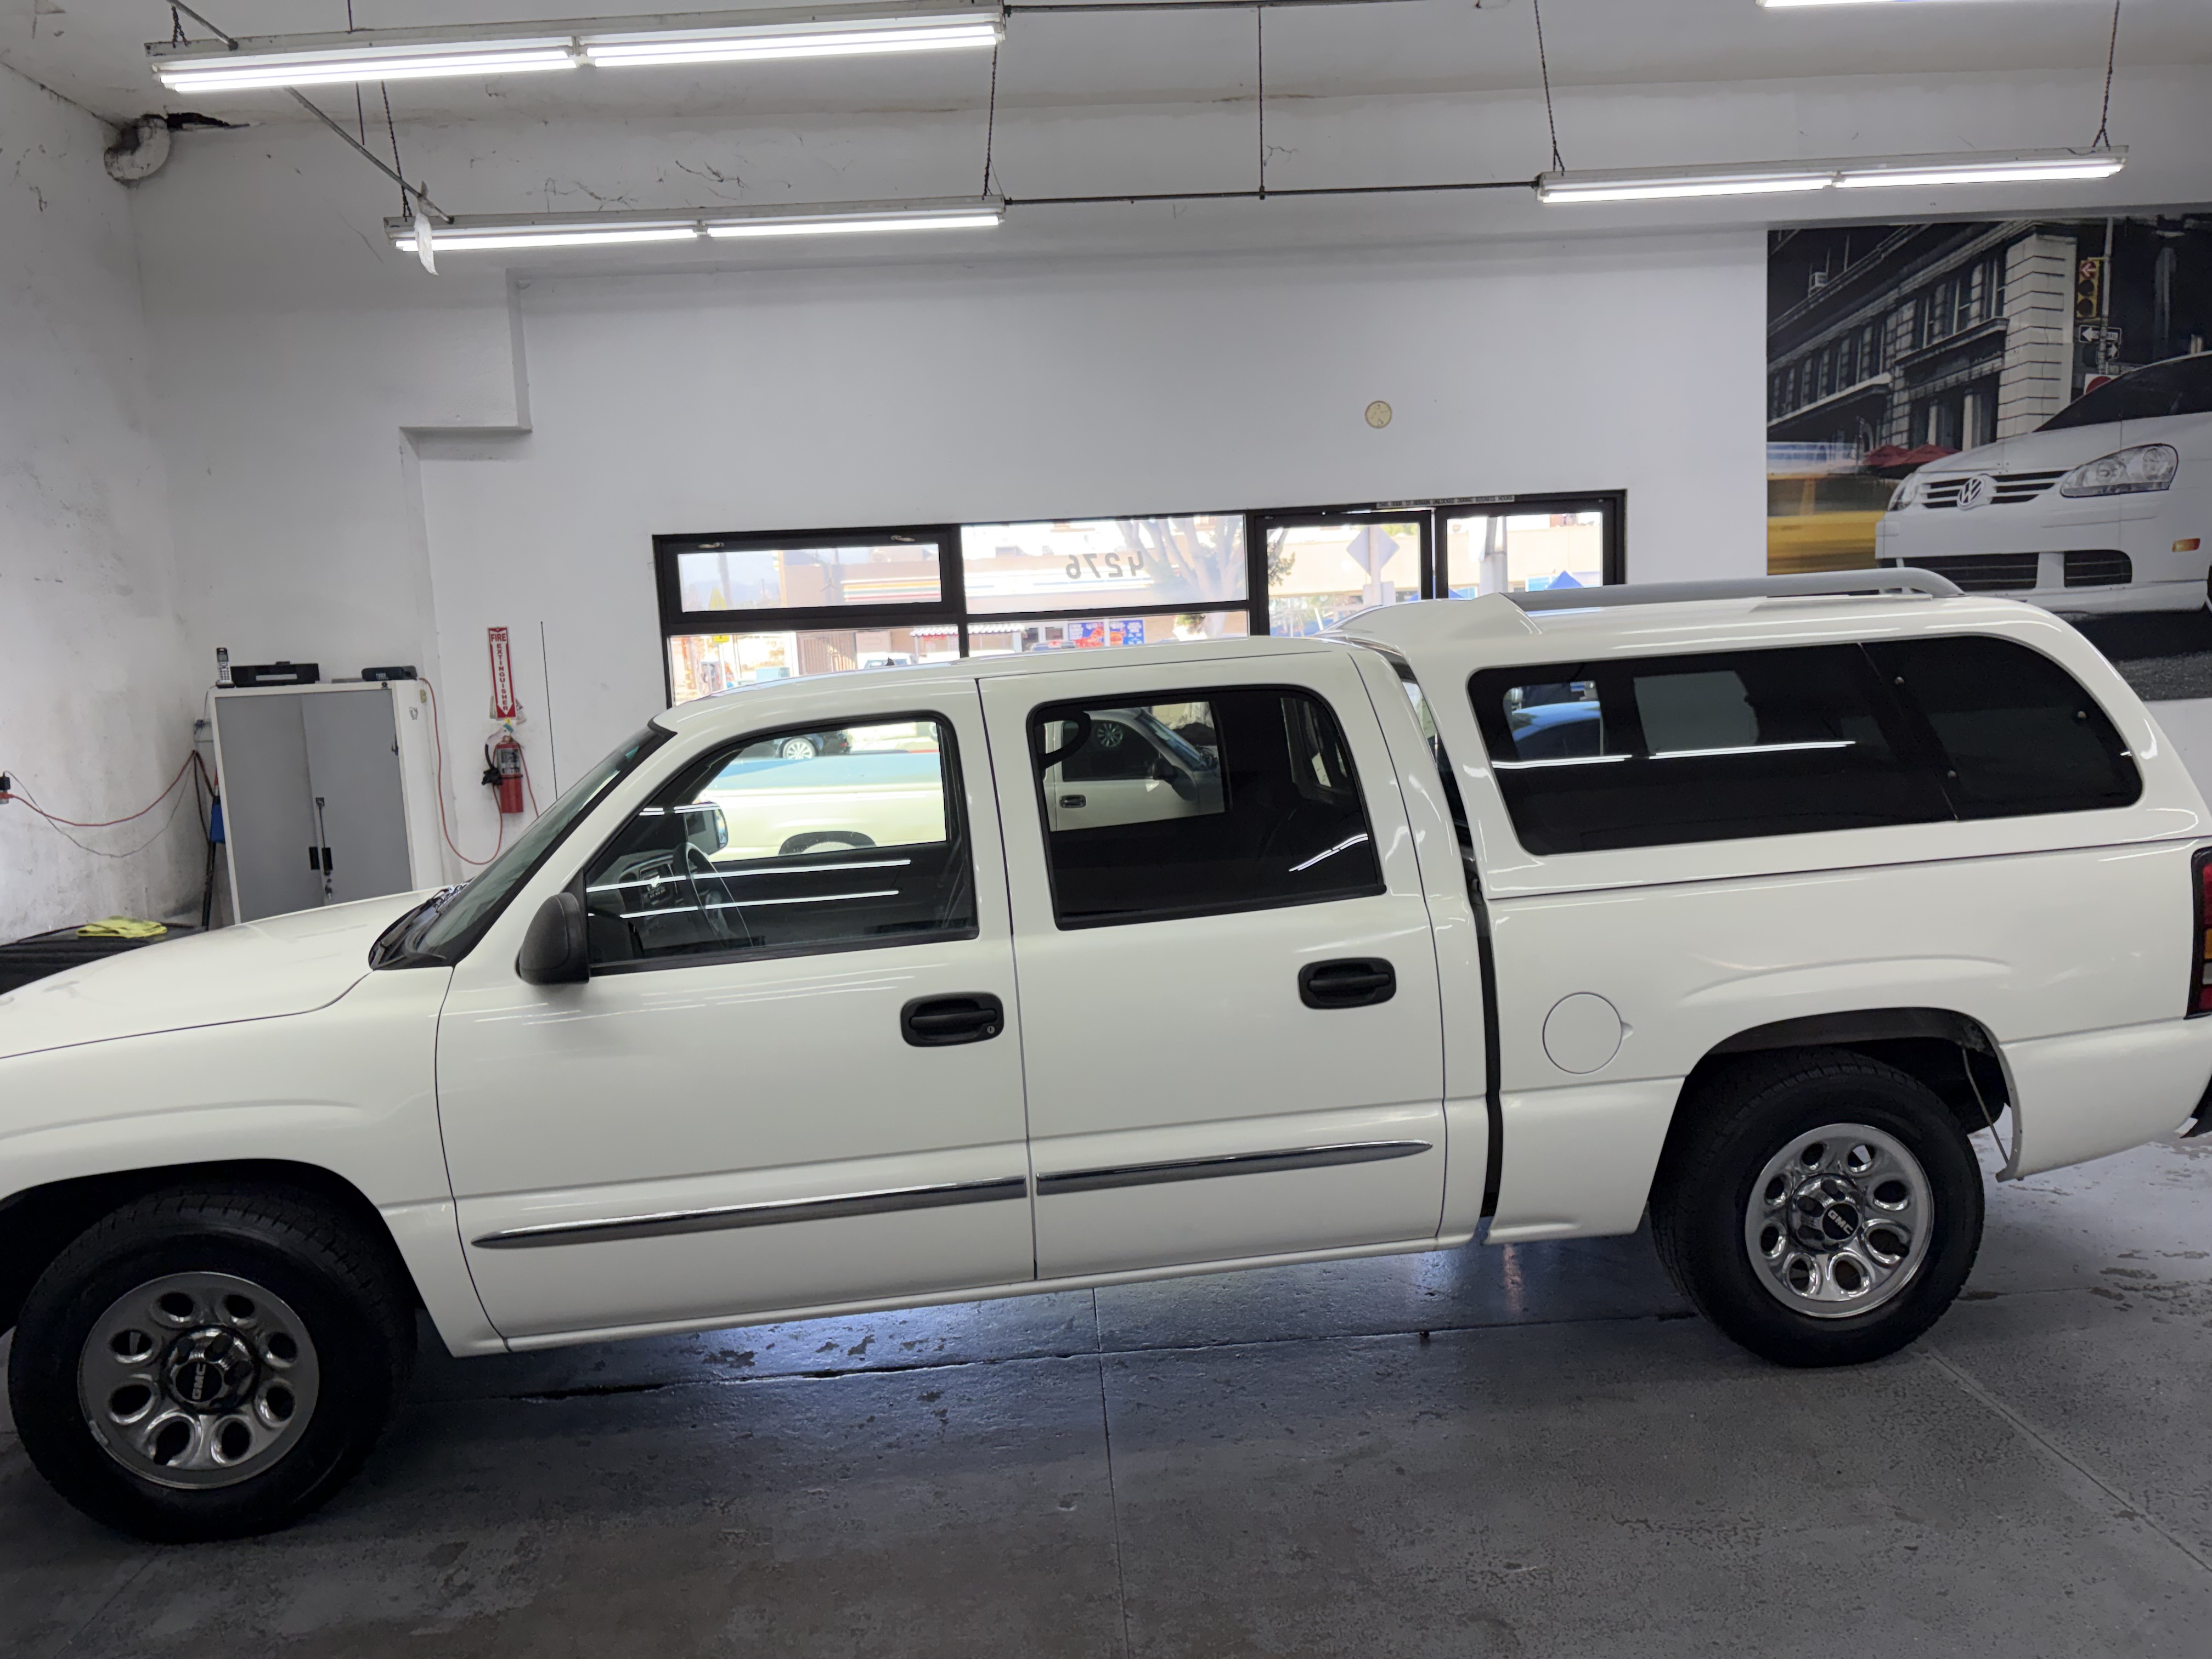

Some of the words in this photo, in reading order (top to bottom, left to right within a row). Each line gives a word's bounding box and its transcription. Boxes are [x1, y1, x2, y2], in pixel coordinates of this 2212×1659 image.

[1959, 478, 1983, 504] VW
[490, 633, 506, 642] FIRE
[496, 643, 508, 711] EXTINGUISHER
[1828, 1209, 1854, 1235] GMC
[191, 1363, 206, 1400] GMC
